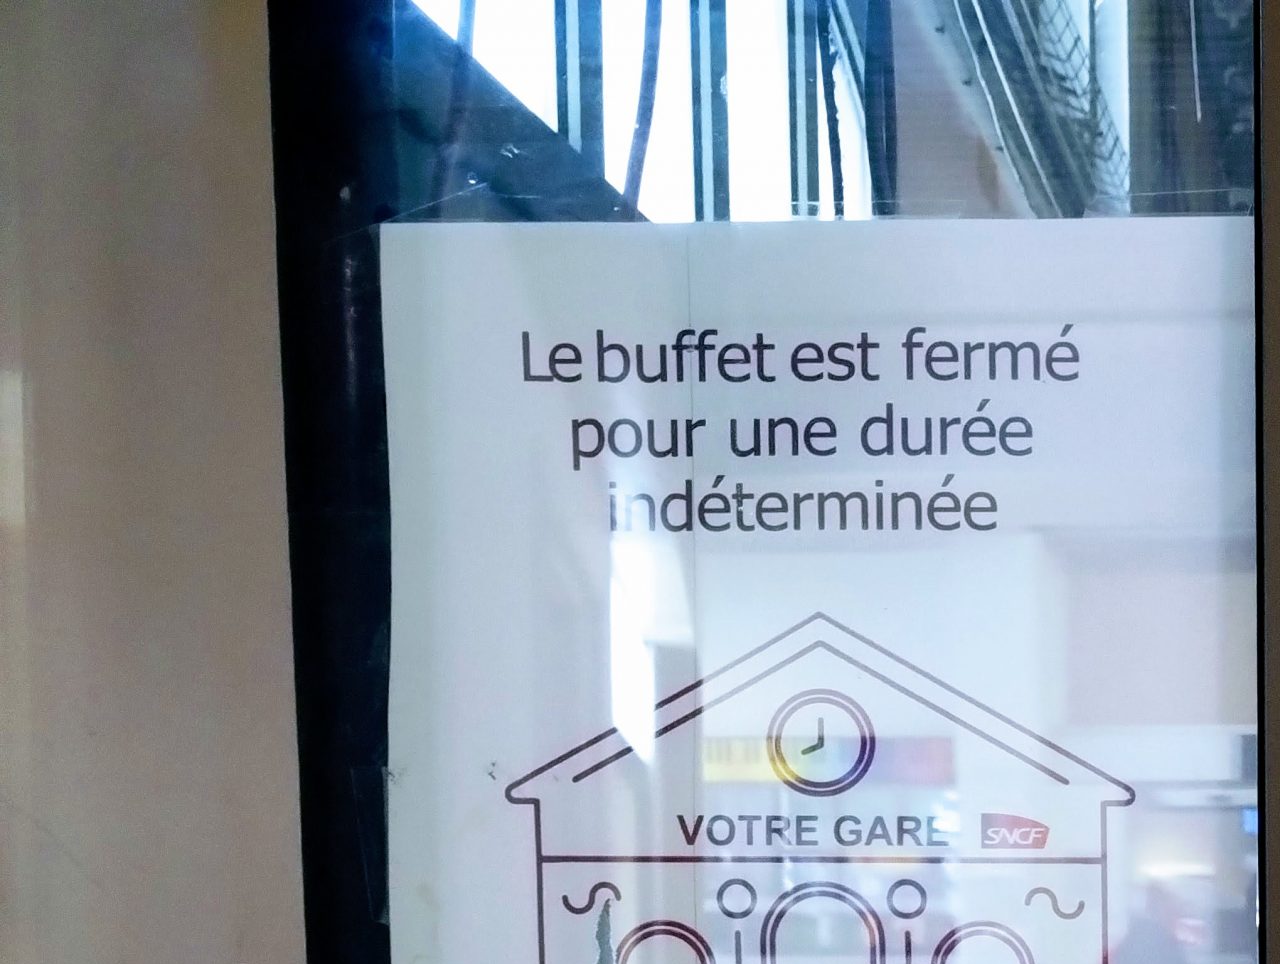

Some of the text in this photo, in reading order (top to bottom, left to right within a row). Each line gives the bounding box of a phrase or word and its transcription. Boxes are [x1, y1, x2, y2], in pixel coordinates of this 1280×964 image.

[521, 323, 1080, 383] Le buffet est fermé
[572, 400, 1033, 469] pour une durée
[609, 474, 998, 532] indéterminée
[677, 813, 949, 847] VOTRE GARE
[983, 827, 1044, 845] SNCF
